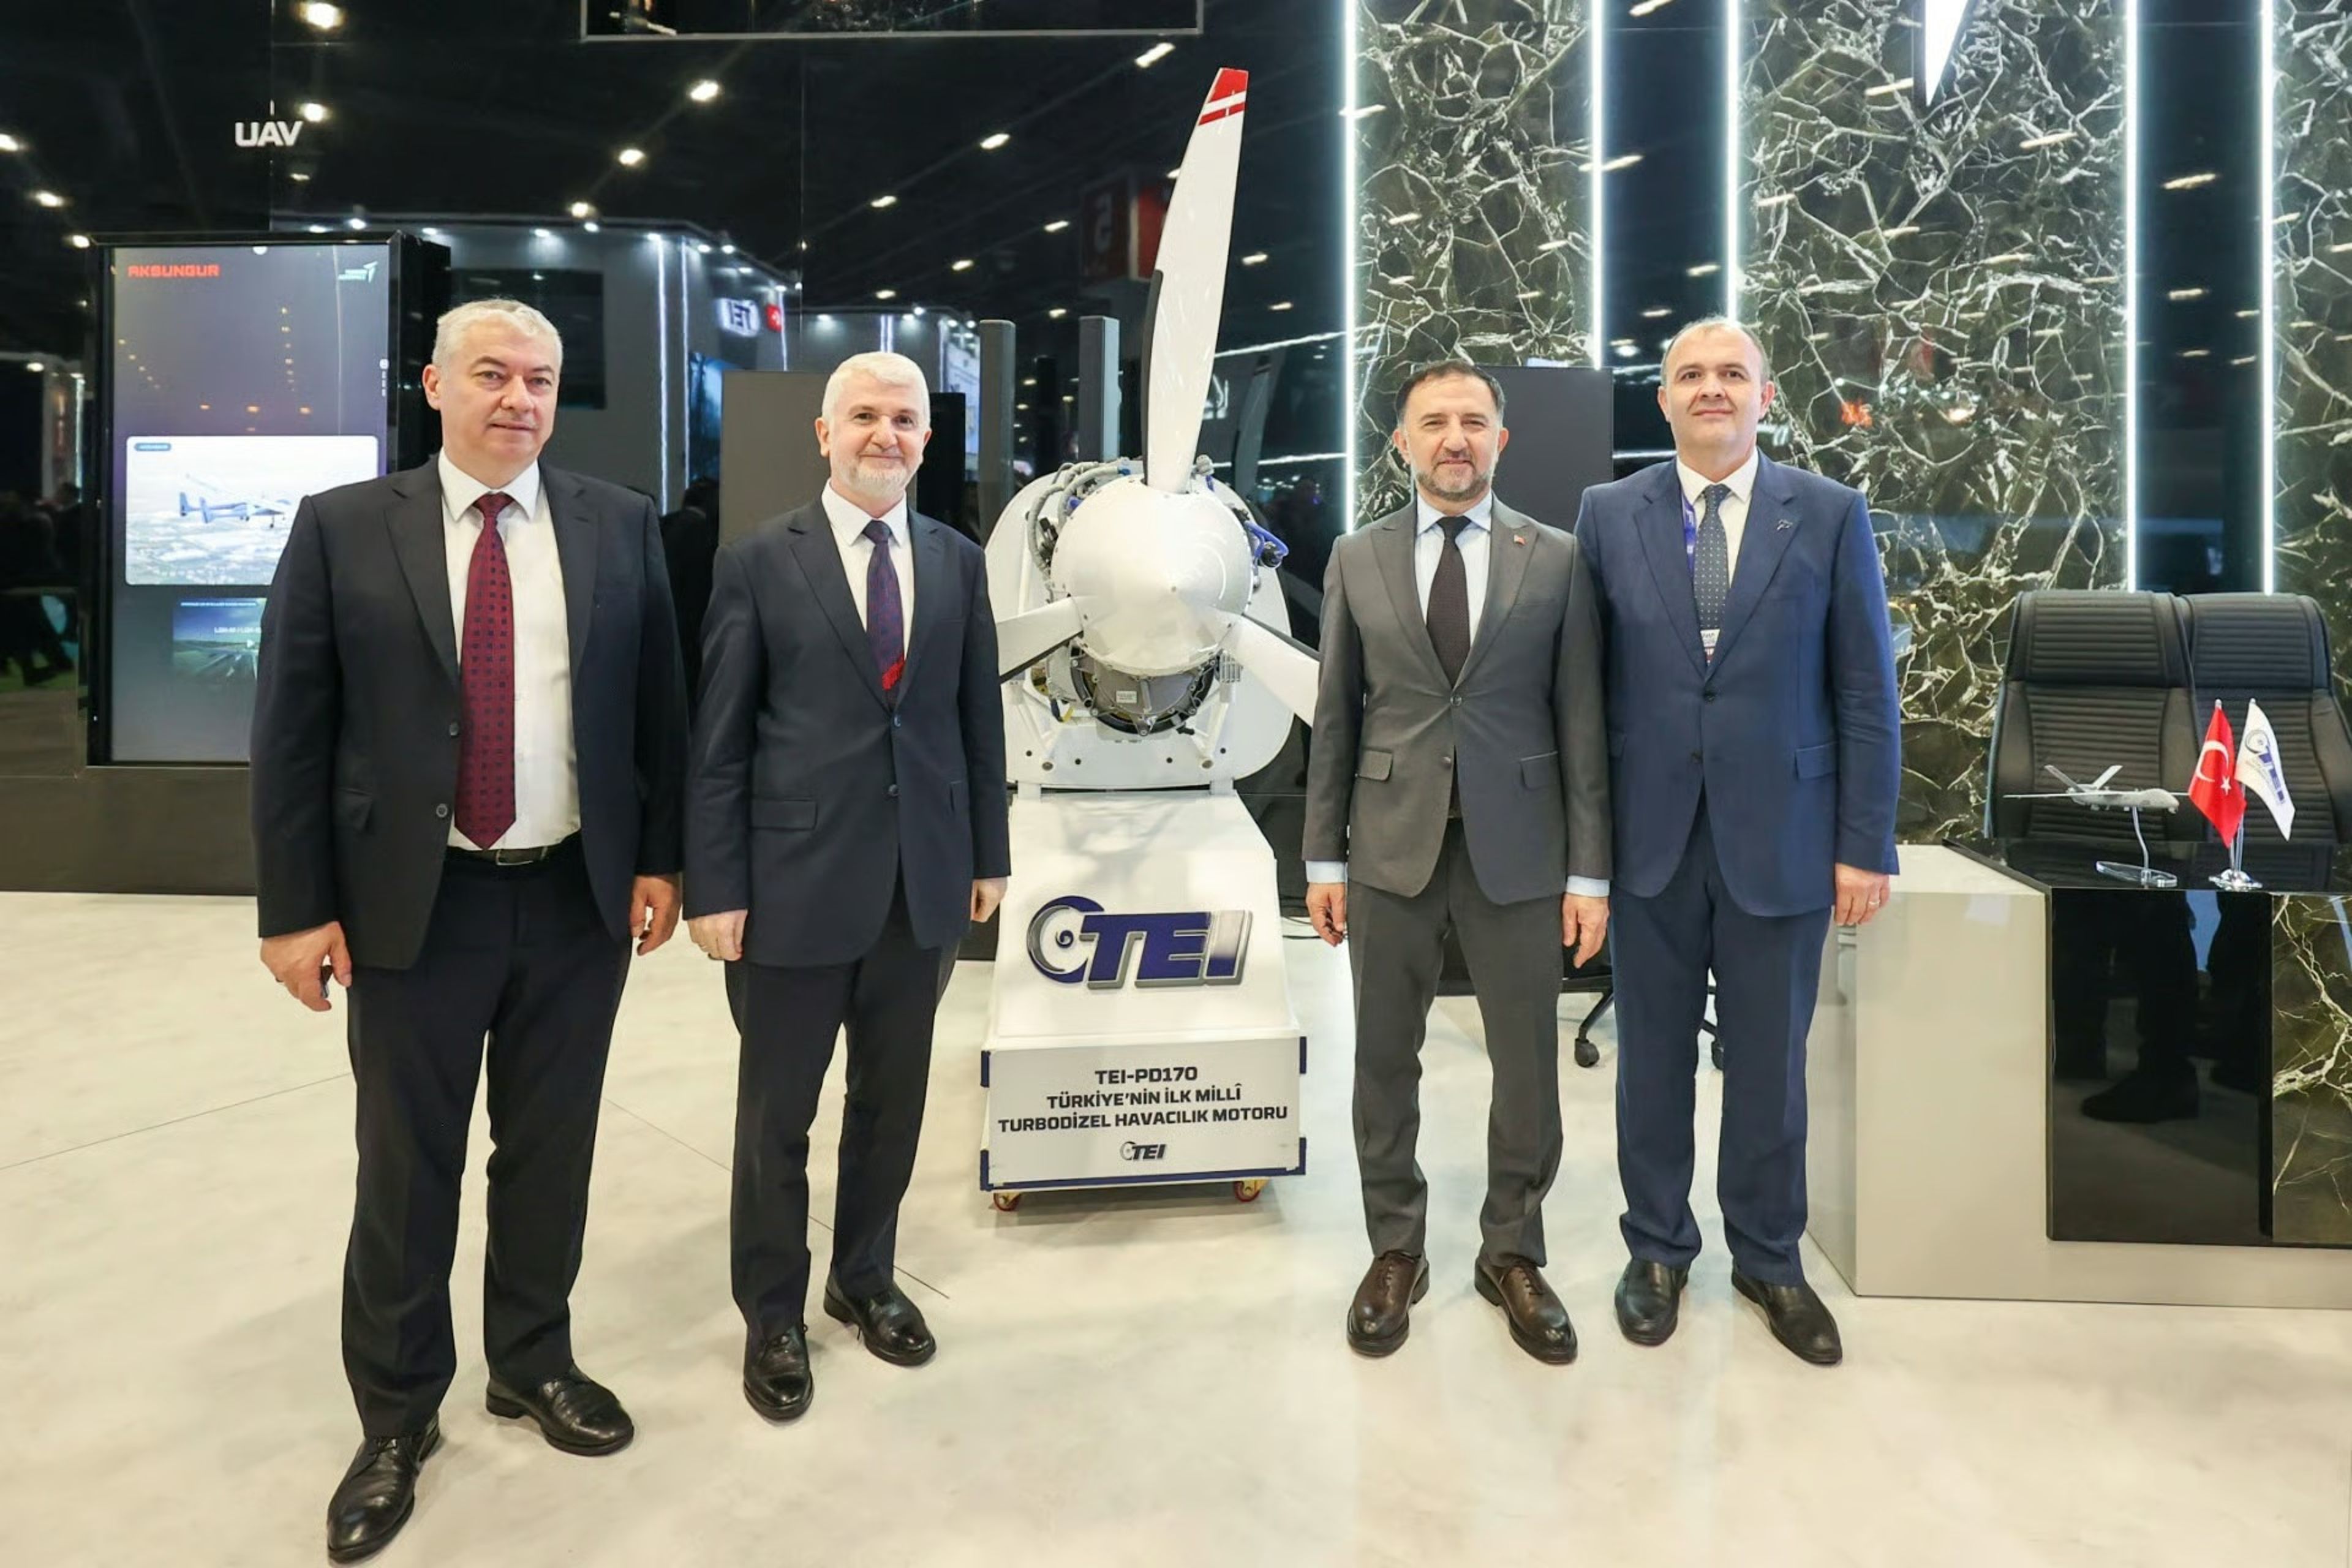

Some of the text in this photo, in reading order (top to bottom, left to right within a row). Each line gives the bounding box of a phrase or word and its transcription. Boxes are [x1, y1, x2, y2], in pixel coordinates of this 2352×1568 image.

[235, 121, 304, 147] UAV
[128, 265, 219, 277] AKSUNGUR
[1095, 1066, 1198, 1085] TEI-PD170
[1164, 1087, 1191, 1103] İLK
[1195, 1082, 1242, 1102] MİLLÎ
[998, 1106, 1288, 1133] TURBODİZEL HAVACILIK MOTORU
